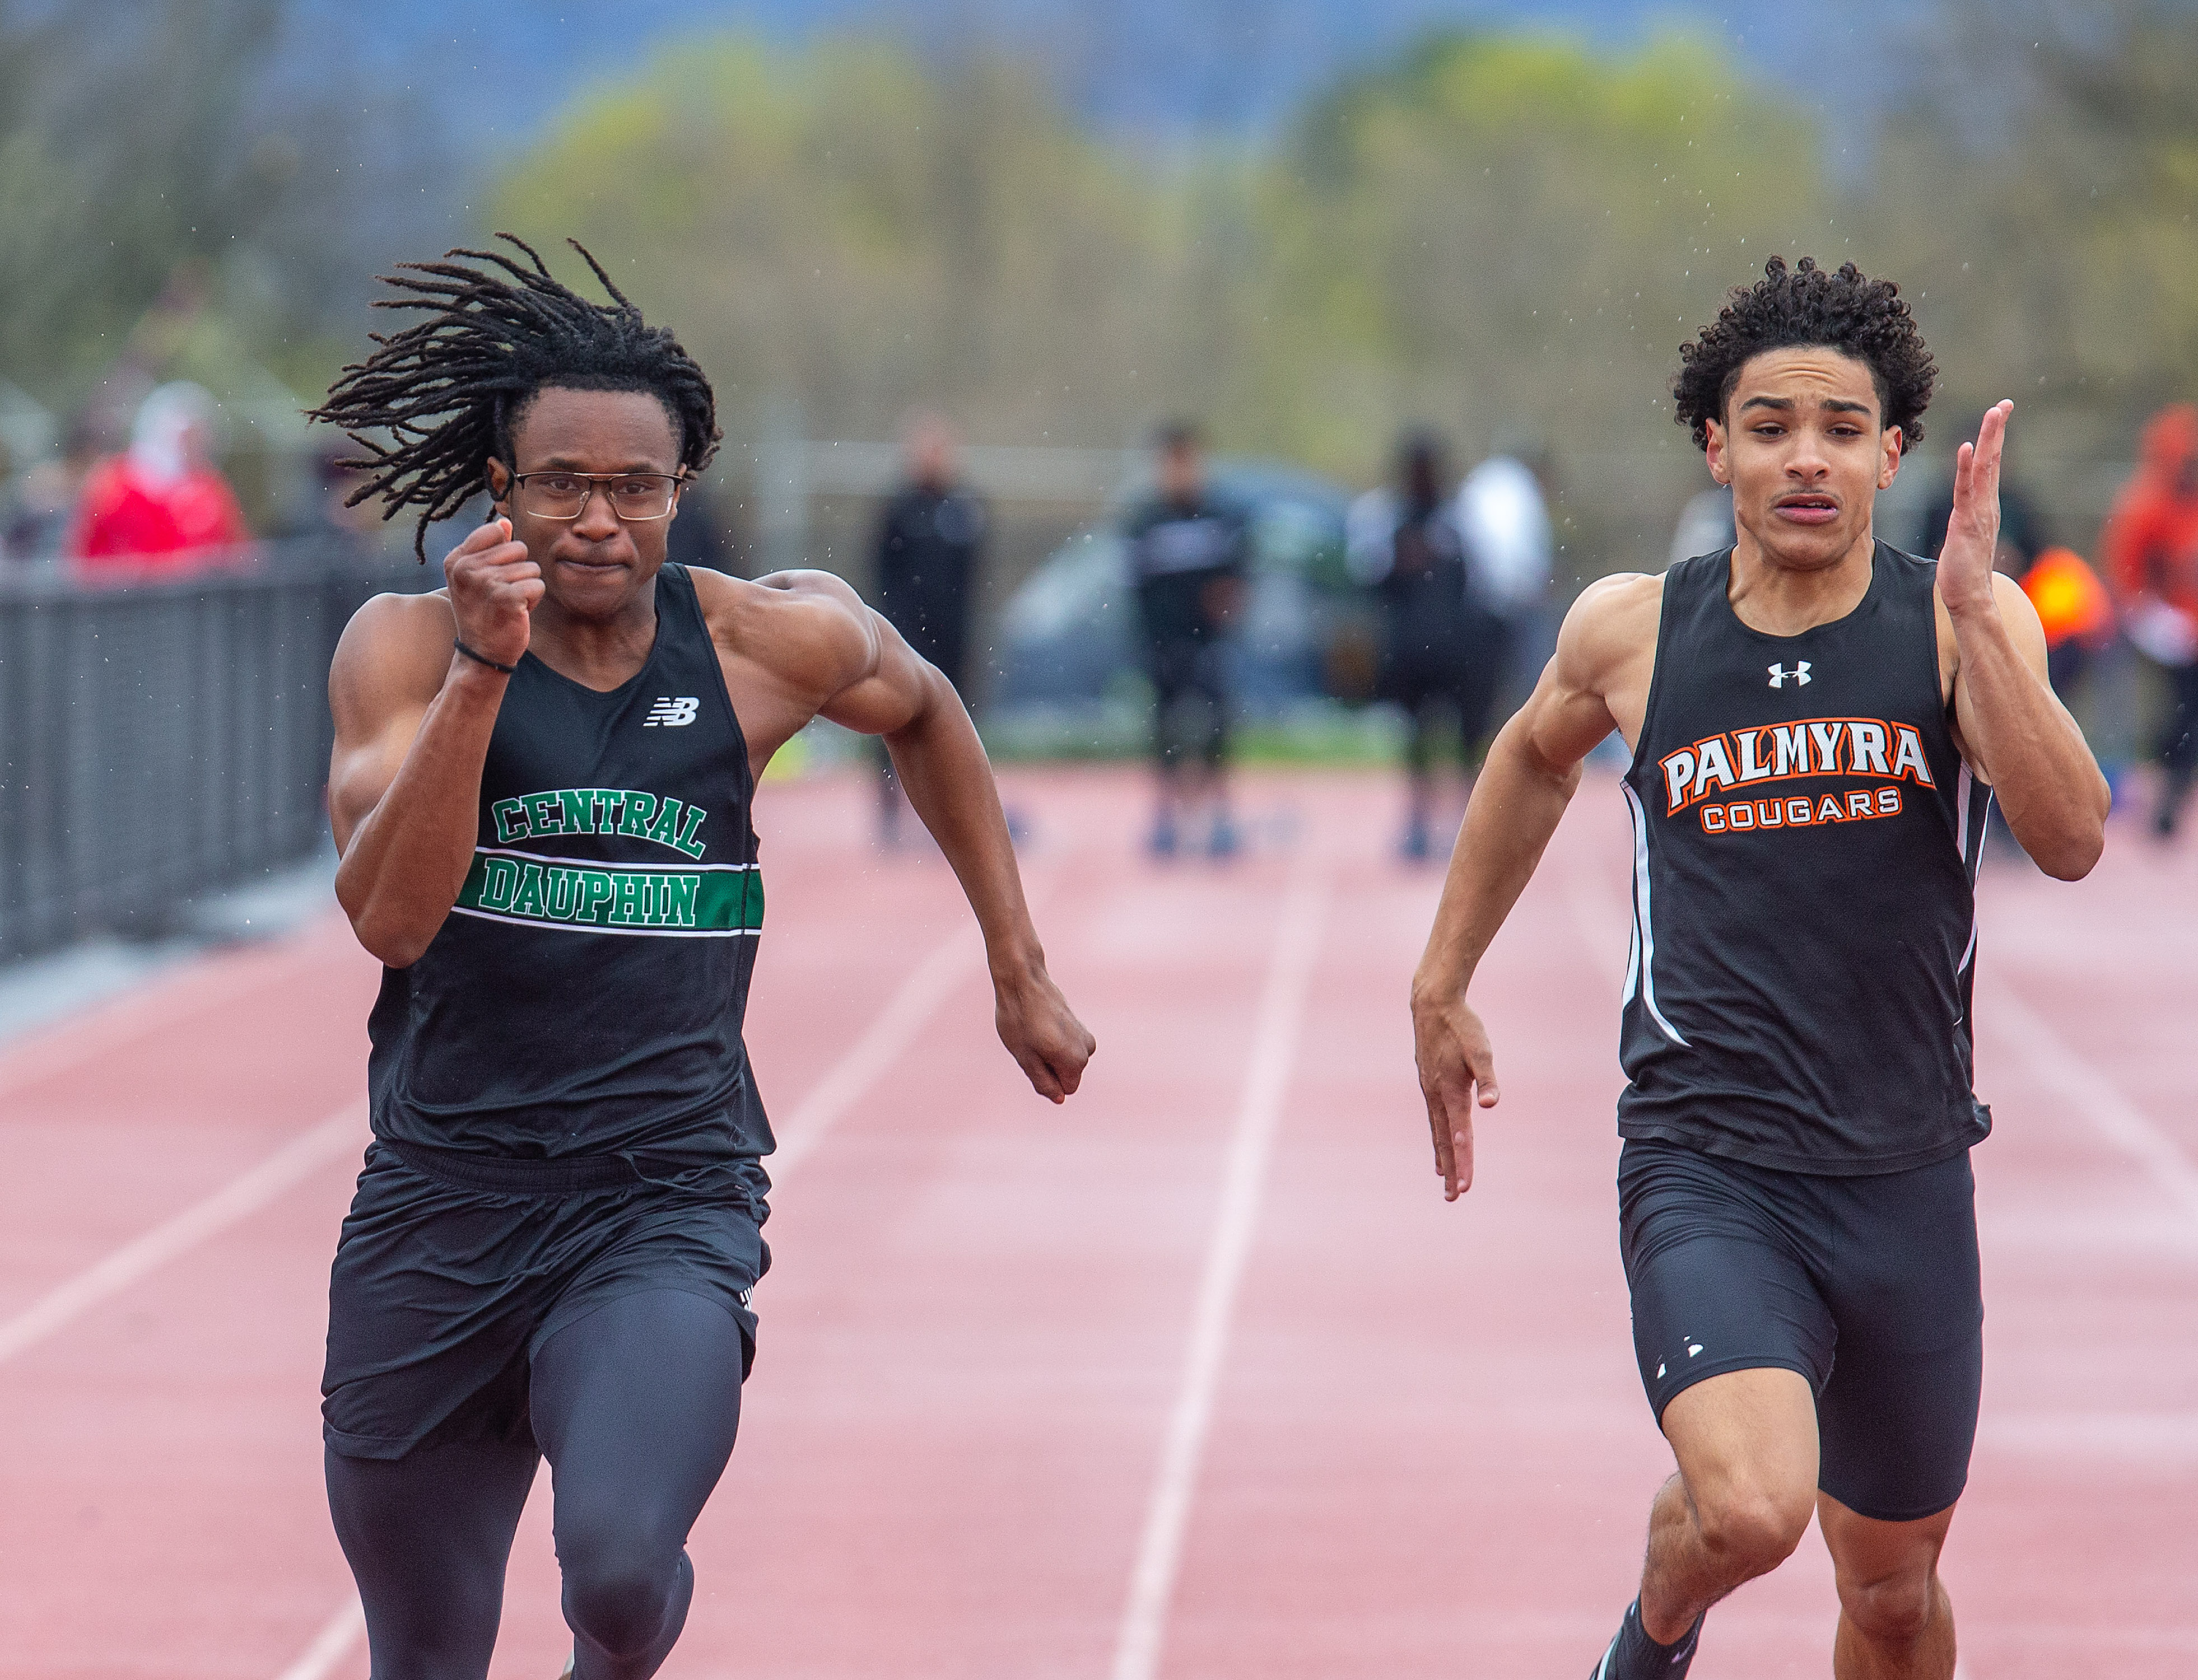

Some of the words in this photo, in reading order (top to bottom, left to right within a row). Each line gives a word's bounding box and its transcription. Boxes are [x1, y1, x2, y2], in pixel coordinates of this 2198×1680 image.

[1658, 717, 1936, 818] PALMYRA
[491, 788, 707, 860] CENTRAL
[1700, 786, 1902, 834] COUGARS
[478, 858, 700, 926] DAUPHIN
